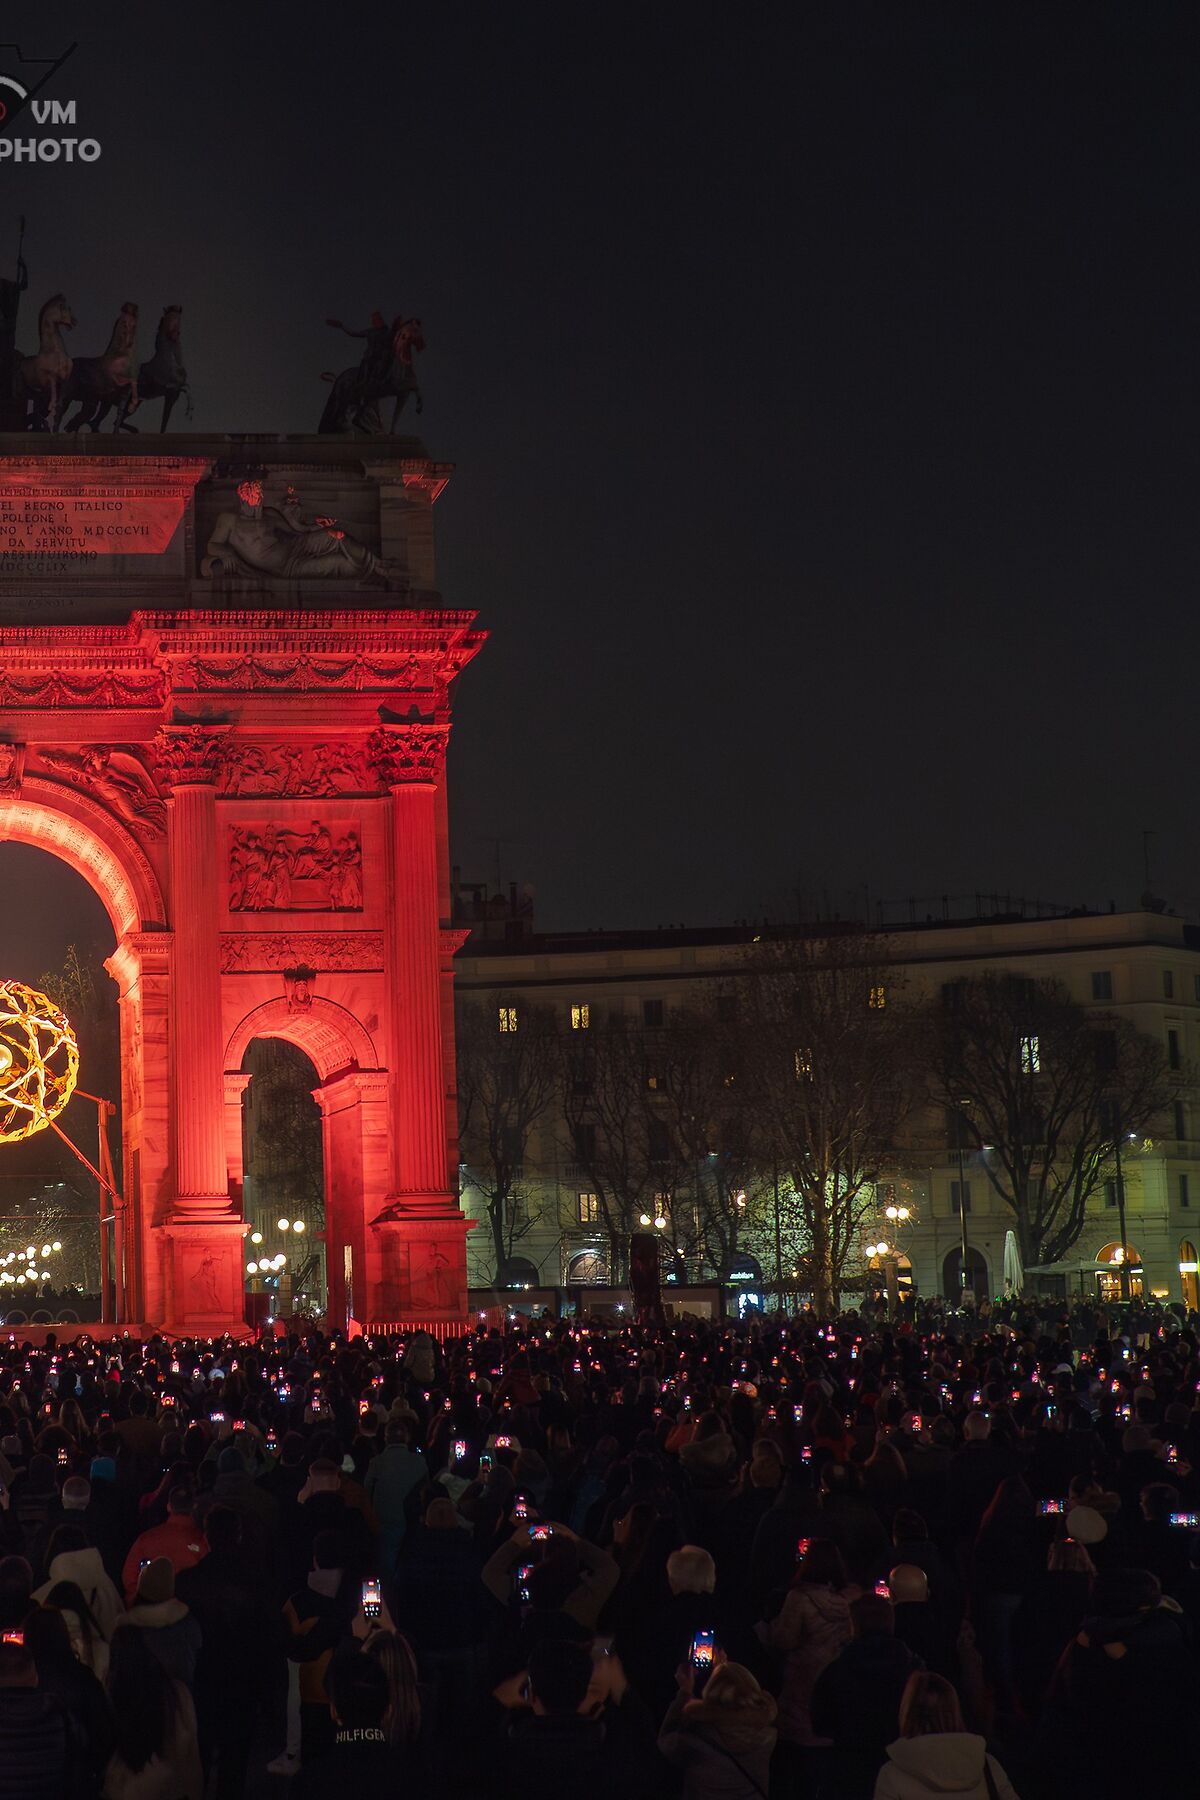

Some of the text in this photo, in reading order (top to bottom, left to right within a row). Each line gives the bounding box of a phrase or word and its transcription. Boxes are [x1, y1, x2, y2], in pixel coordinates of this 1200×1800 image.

[24, 501, 65, 511] REGNO
[74, 501, 123, 512] ITALICO
[83, 525, 149, 536] MDCCCVII
[8, 537, 26, 547] DA
[35, 537, 86, 547] SERVITU
[3, 550, 98, 560] RESTITUIRONO
